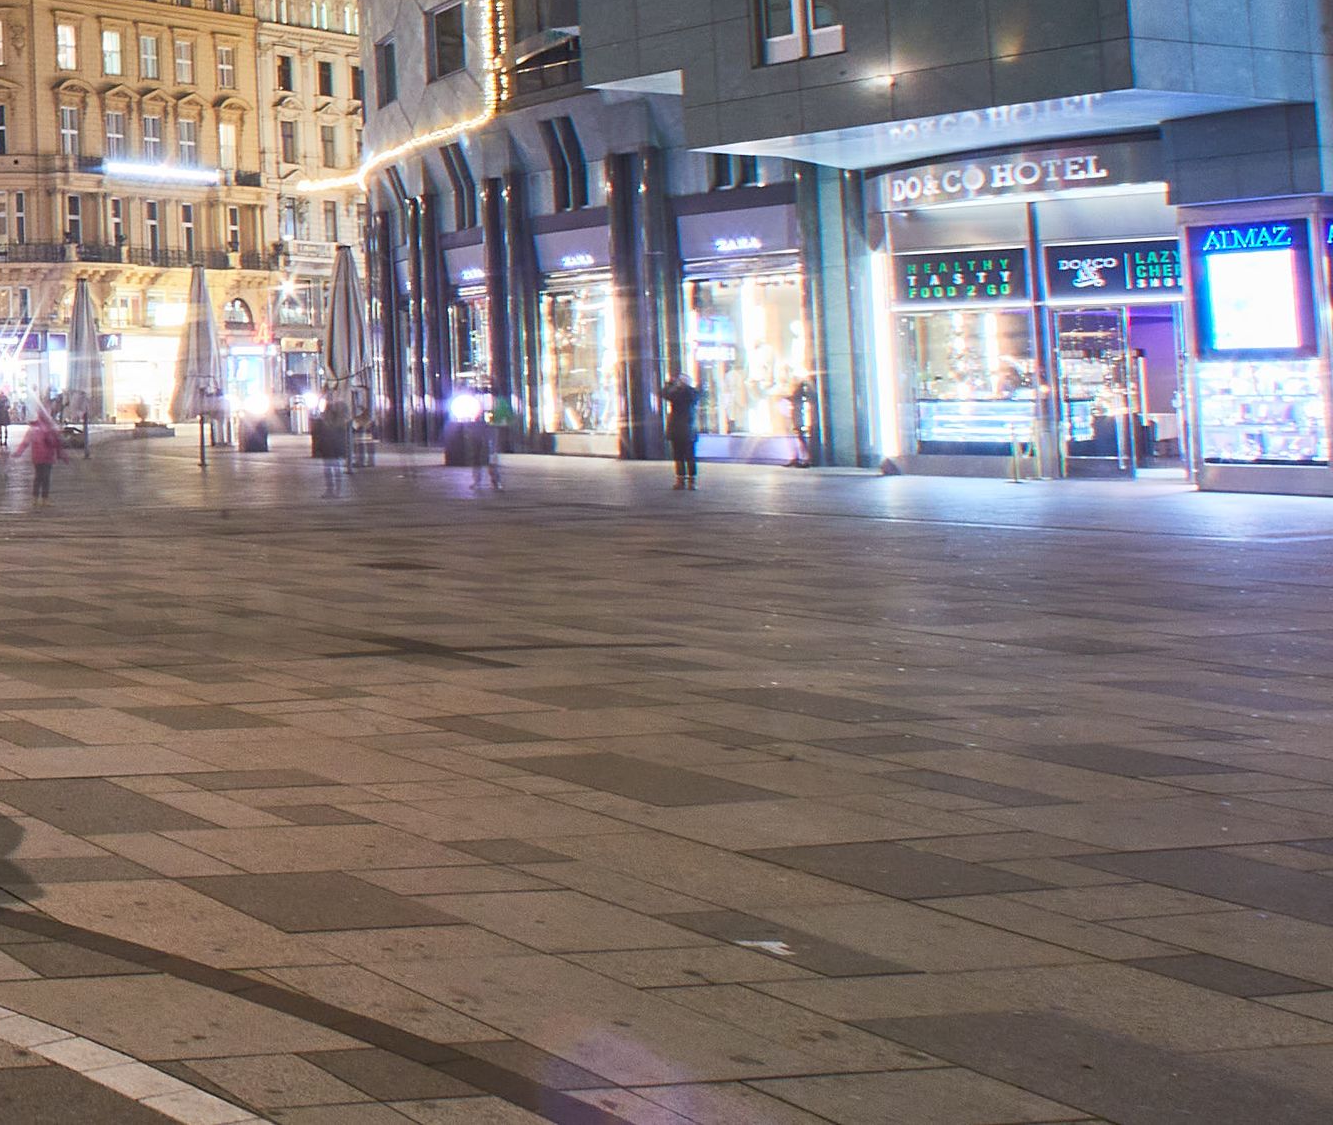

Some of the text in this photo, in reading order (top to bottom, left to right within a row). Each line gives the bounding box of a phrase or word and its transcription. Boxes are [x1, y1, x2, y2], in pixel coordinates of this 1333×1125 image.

[990, 155, 1109, 188] HOTEL
[1203, 225, 1292, 251] ALMAZ
[907, 258, 1009, 274] HEALTHY
[907, 271, 1011, 286] TASTY
[908, 283, 1011, 298] FOOD 2 GO
